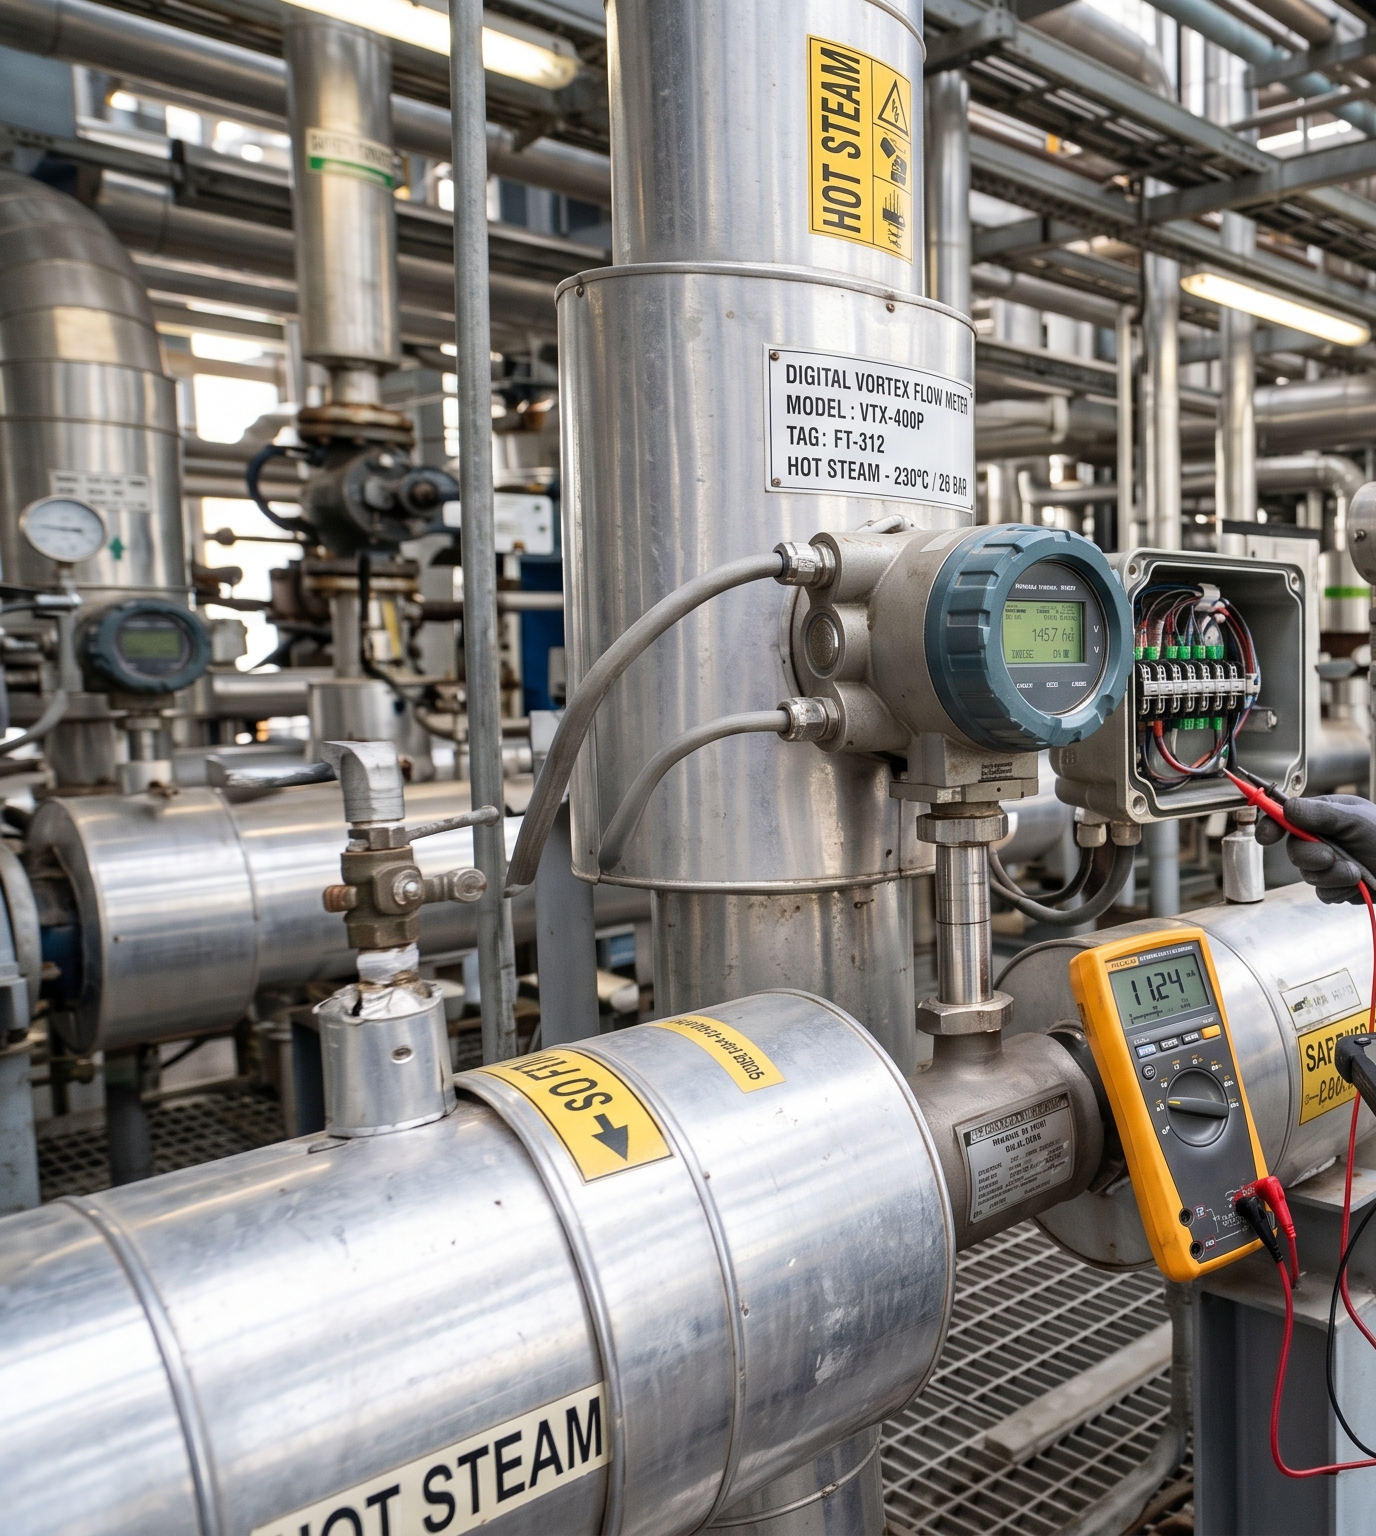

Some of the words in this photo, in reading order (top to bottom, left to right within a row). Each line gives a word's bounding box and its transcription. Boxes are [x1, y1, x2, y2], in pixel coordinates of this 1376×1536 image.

[820, 46, 861, 160] STEAM
[821, 163, 862, 234] HOT
[786, 364, 851, 390] DIGITAL
[855, 372, 910, 399] VORTEX
[914, 382, 943, 407] FLOW
[945, 390, 968, 415] METER
[786, 394, 847, 420] MODEL
[860, 402, 924, 431] VTX-400P
[834, 429, 885, 454] FT-312
[787, 456, 822, 478] HOT
[827, 458, 880, 483] STEAM
[953, 475, 967, 497] BAR
[276, 1483, 400, 1536] OT
[421, 1395, 603, 1535] STEAM
